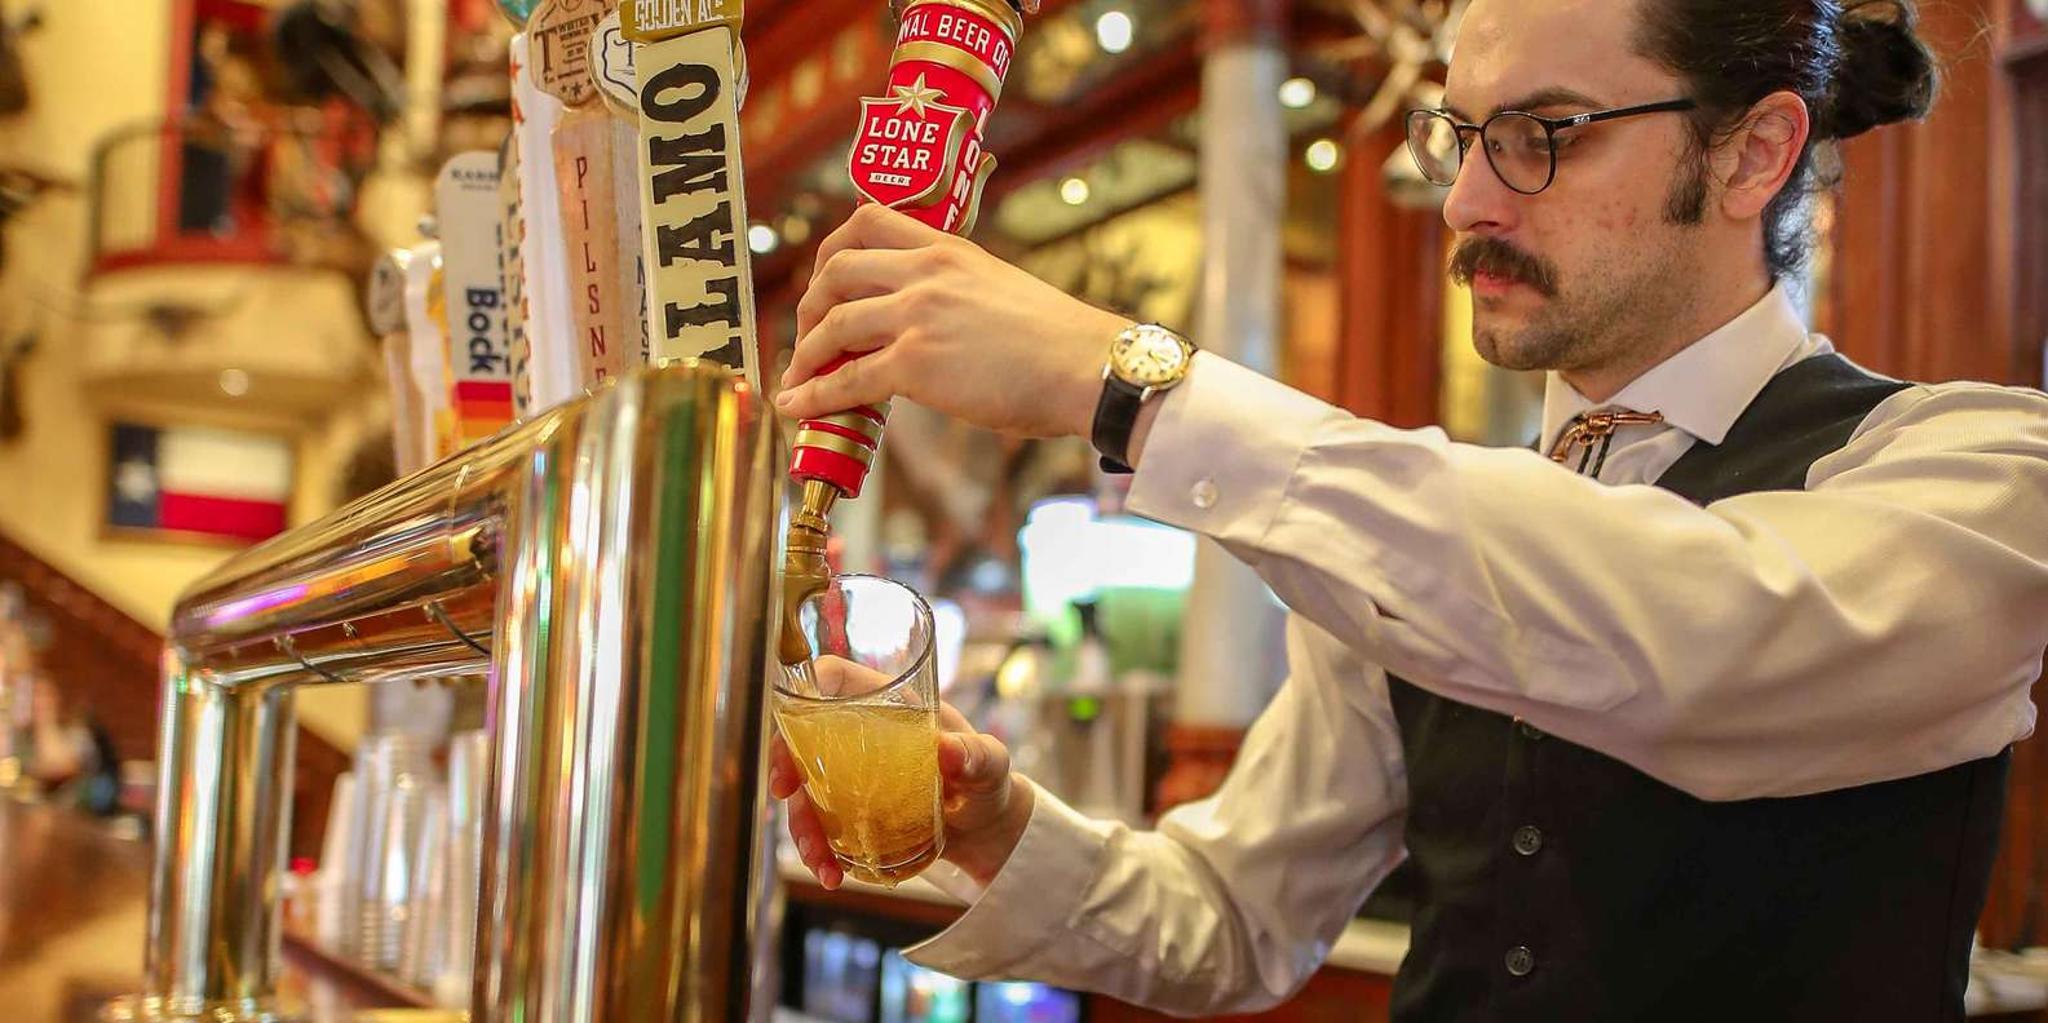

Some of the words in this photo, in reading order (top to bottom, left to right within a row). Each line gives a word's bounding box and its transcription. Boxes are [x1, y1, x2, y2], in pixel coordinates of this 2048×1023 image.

[937, 14, 990, 54] BEER
[868, 117, 940, 144] LONE
[860, 144, 931, 171] STAR
[875, 174, 905, 184] BEER
[465, 287, 503, 374] Bock
